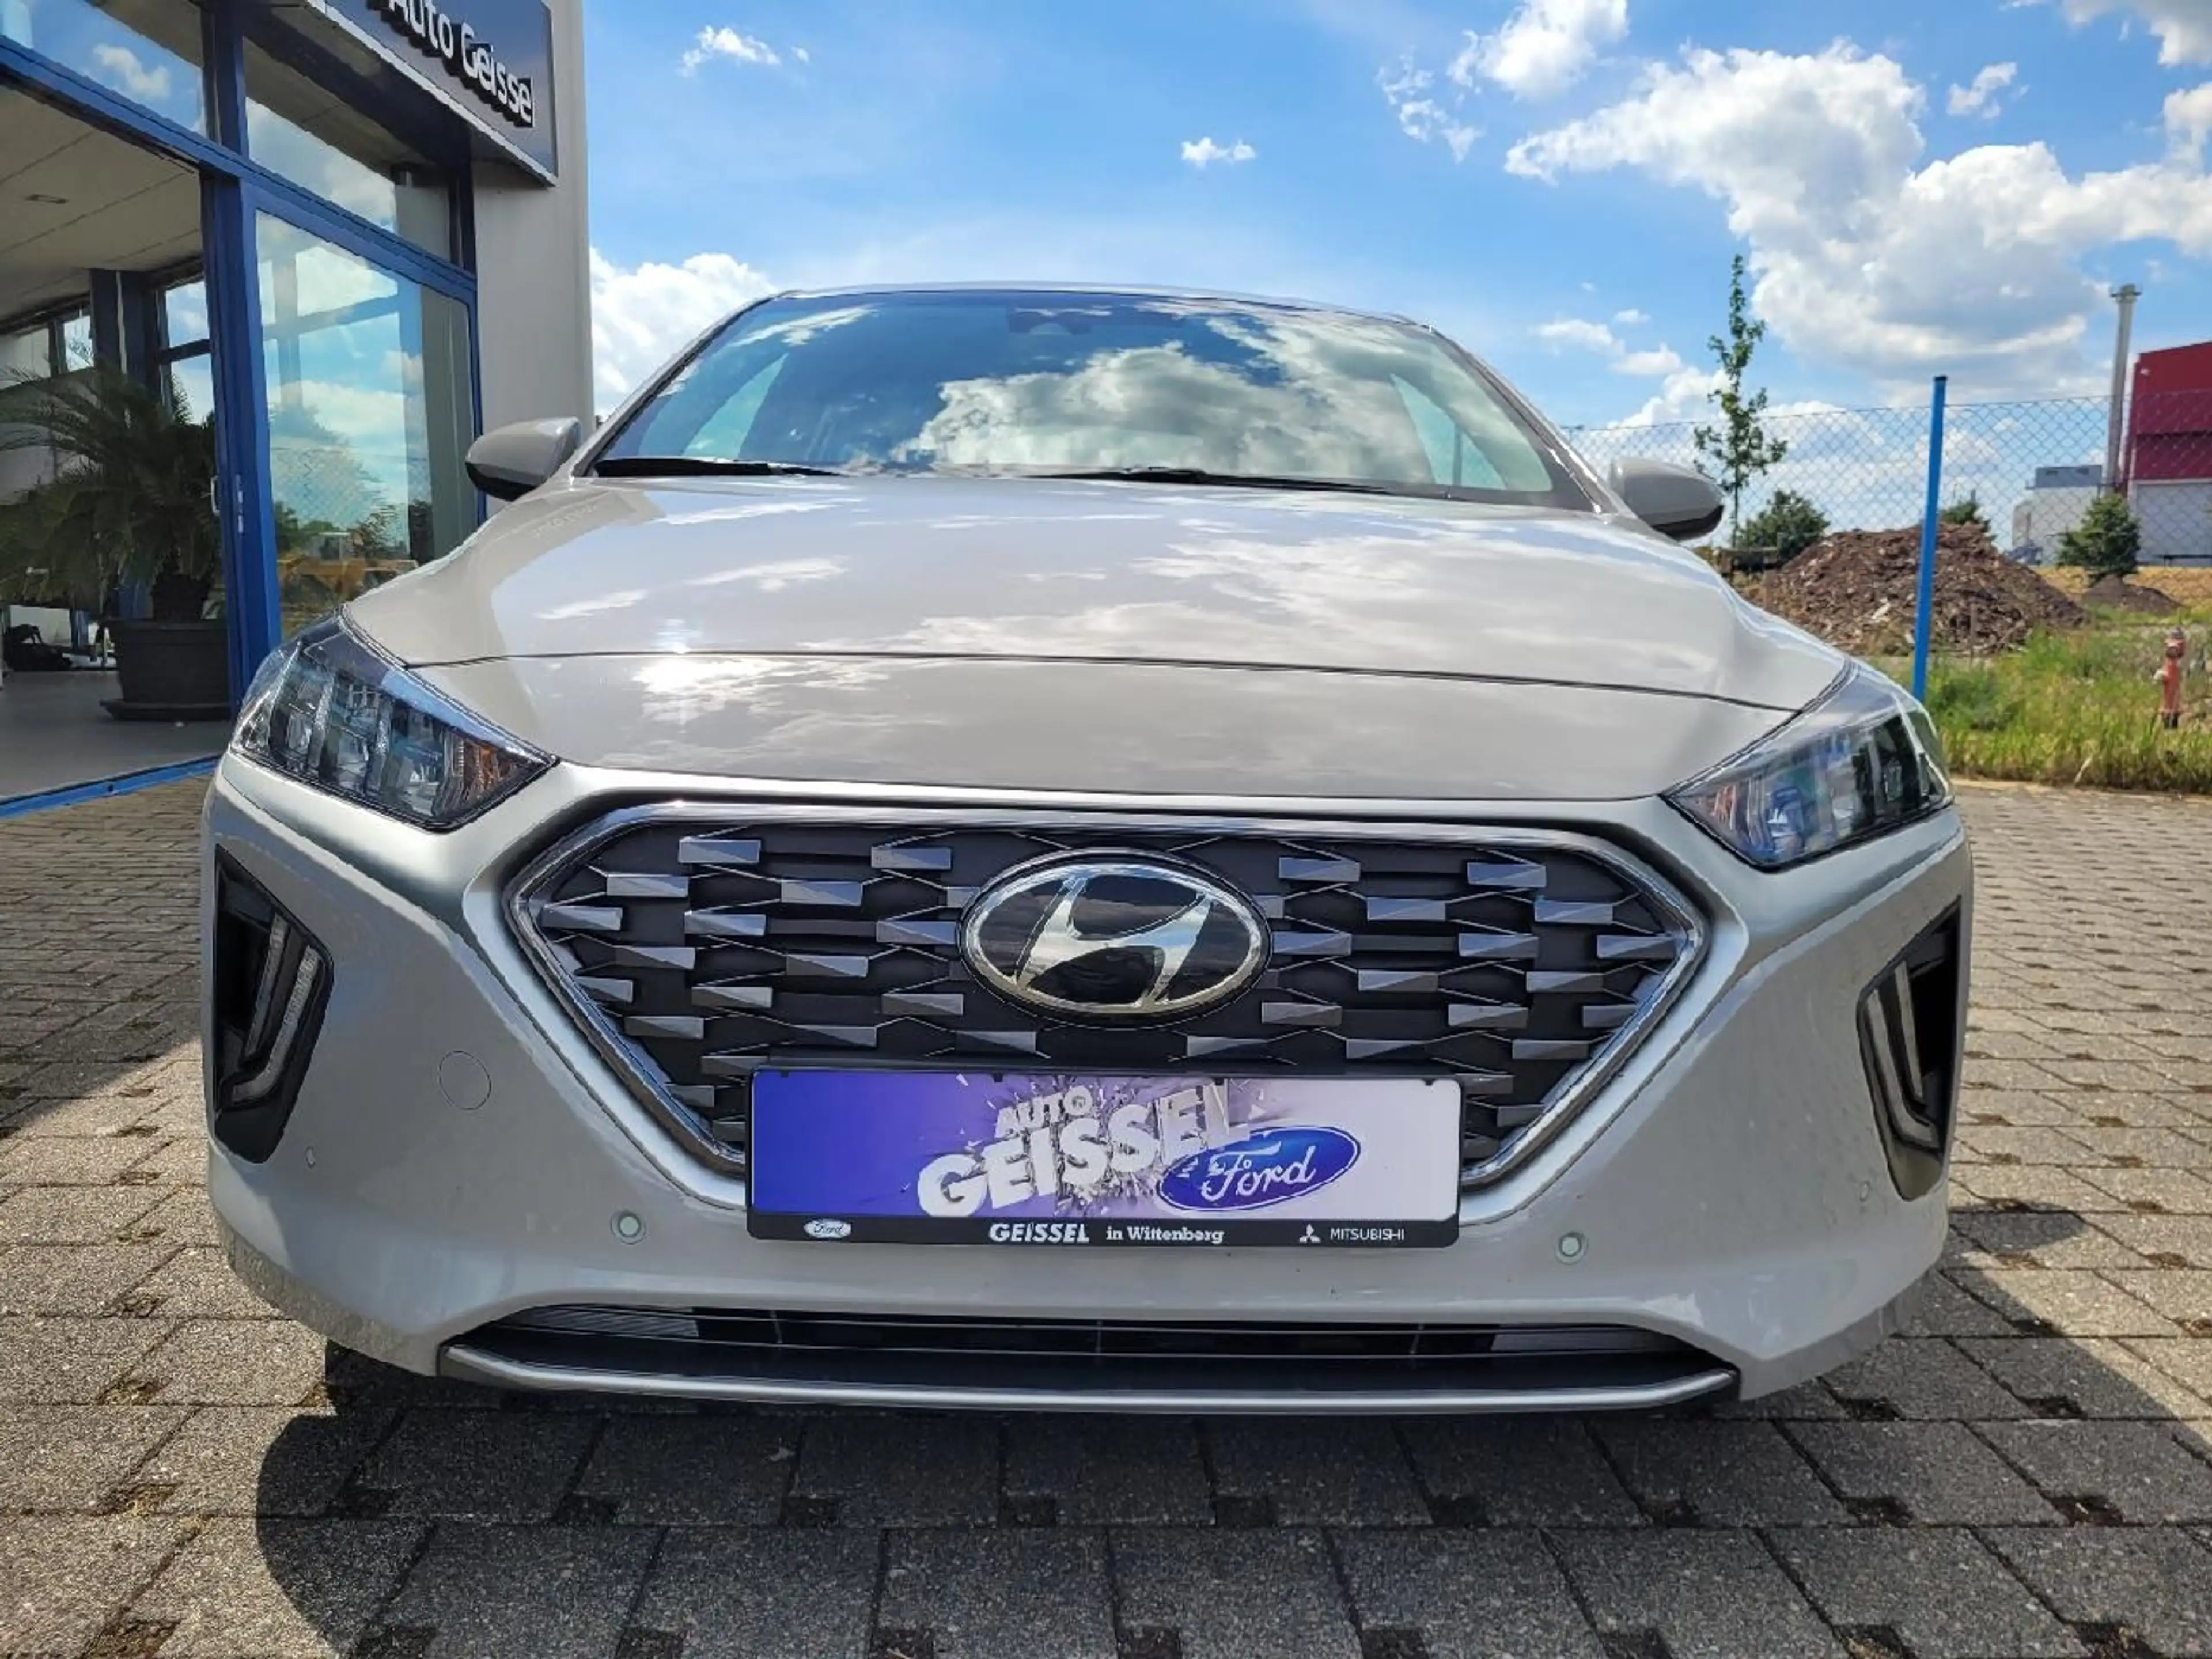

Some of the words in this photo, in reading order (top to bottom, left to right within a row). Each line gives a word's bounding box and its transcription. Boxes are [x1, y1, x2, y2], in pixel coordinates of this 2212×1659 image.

[994, 1085, 1093, 1139] AUTO
[917, 1084, 1251, 1217] GEISSEL
[1200, 1141, 1316, 1202] Ford
[988, 1223, 1090, 1244] GEISSEL
[1107, 1227, 1124, 1240] in
[1126, 1226, 1225, 1244] Wittenberg
[1330, 1228, 1404, 1240] MITSUBISHI
